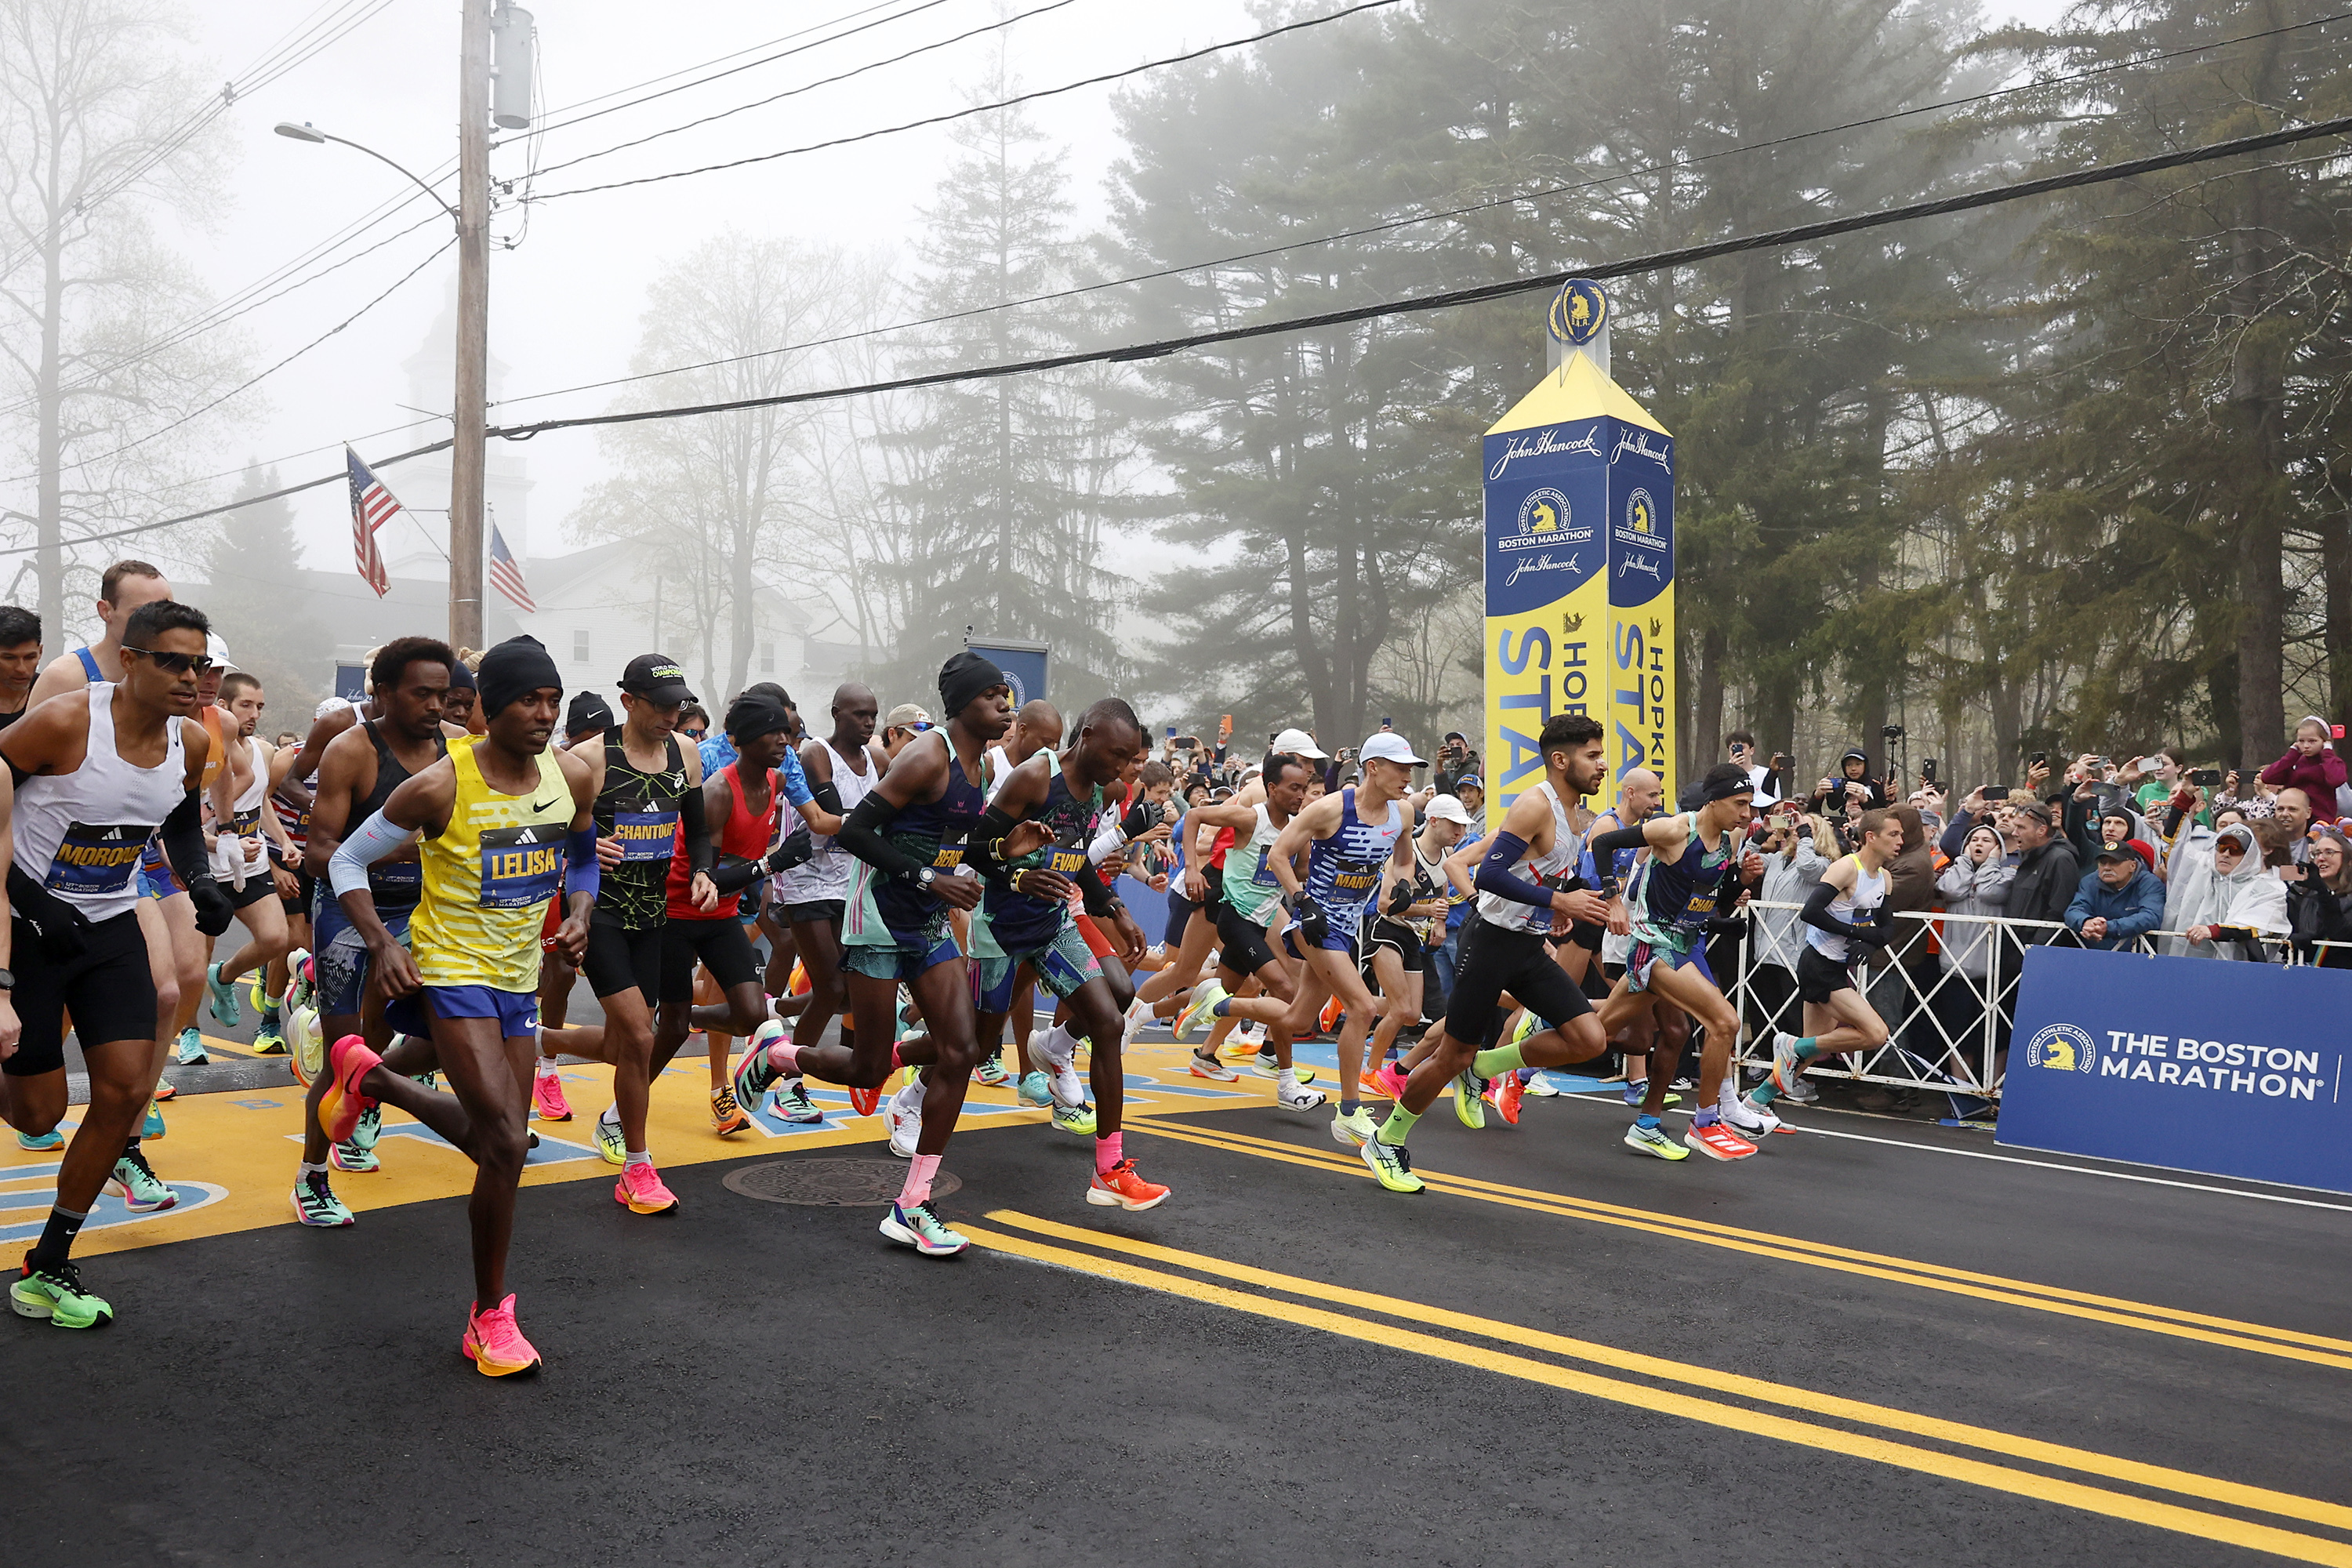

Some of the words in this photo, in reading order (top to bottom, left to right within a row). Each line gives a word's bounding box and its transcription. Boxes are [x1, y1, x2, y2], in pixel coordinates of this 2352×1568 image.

[1490, 437, 1534, 481] John
[1610, 426, 1637, 465] John
[1526, 490, 1550, 507] ATHLETIC
[1550, 491, 1569, 528] ASSOCIATION
[1498, 536, 1536, 549] BOSTON
[1615, 528, 1636, 542] BOSTON
[1505, 557, 1537, 586] John
[1618, 550, 1637, 578] John
[1498, 626, 1552, 808] STA
[1616, 621, 1645, 805] STA
[492, 847, 557, 880] LELISA
[932, 849, 964, 868] BENS
[1050, 852, 1087, 872] EVAN
[2030, 1036, 2042, 1064] BOSTON
[2041, 1026, 2074, 1039] ATHLETIC
[2072, 1029, 2092, 1071] ASSOCIATION
[2107, 1030, 2169, 1058] THE
[2176, 1037, 2319, 1074] BOSTON
